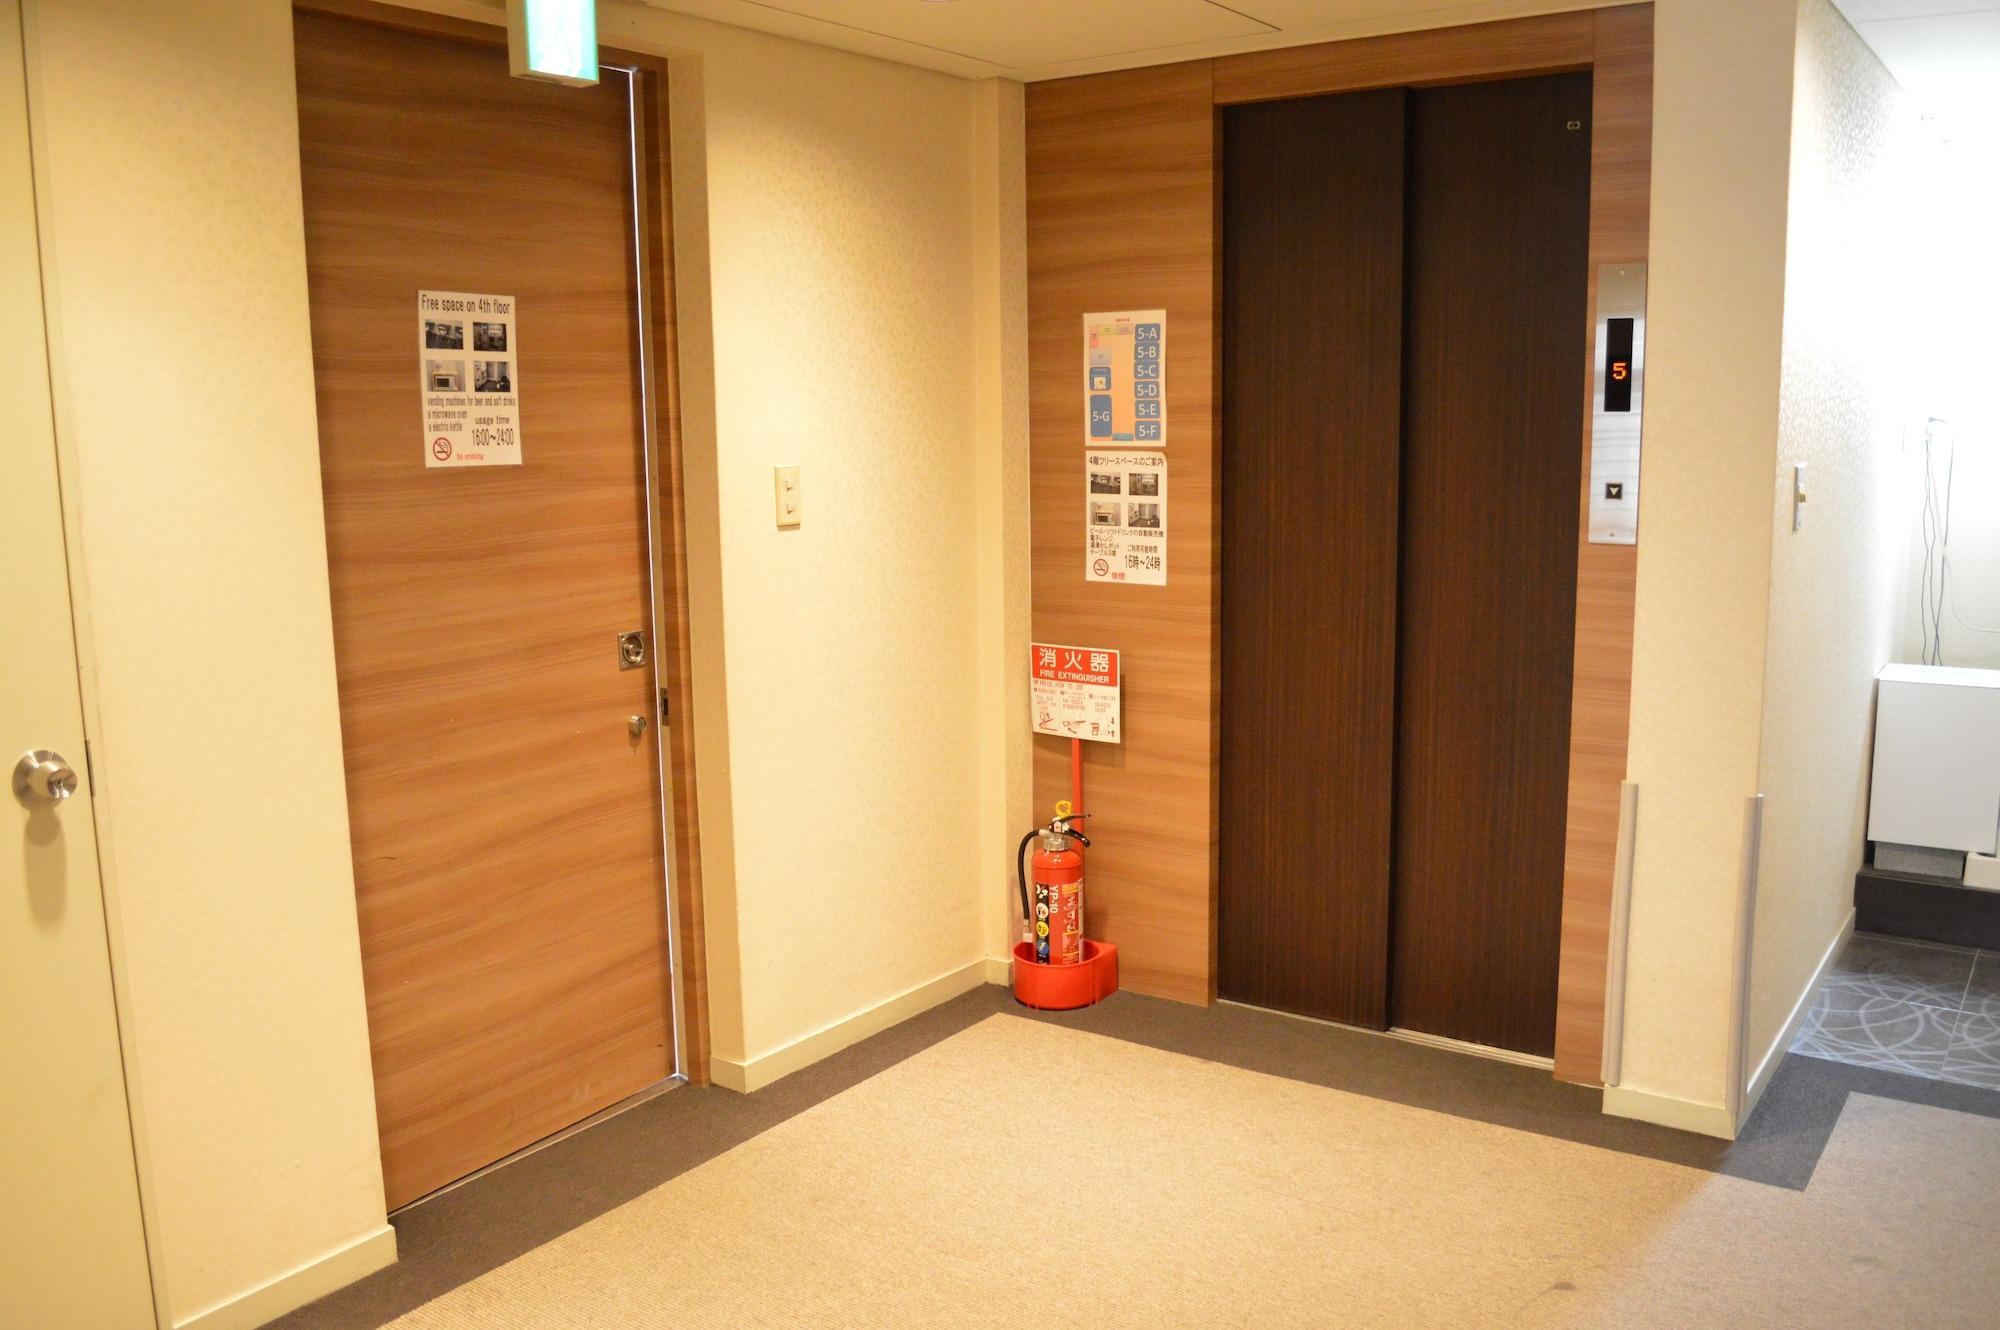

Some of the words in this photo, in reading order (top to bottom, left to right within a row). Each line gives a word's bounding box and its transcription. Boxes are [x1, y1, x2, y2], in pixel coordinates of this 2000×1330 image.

[422, 294, 440, 311] Free
[442, 298, 464, 314] space
[466, 301, 476, 313] on
[478, 299, 491, 314] 4th
[494, 299, 510, 315] floor
[1138, 328, 1157, 340] 5-A
[1137, 346, 1156, 358] 5-B
[1137, 364, 1157, 377] 5-C
[1612, 362, 1627, 380] 5
[1137, 384, 1157, 396] 5-D
[428, 396, 445, 408] vending
[446, 395, 466, 407] machines
[432, 409, 456, 419] microwave
[457, 411, 468, 419] oven
[1138, 403, 1157, 416] 5-E
[475, 417, 494, 426] usage
[496, 416, 510, 425] time
[1092, 411, 1110, 422] 5-G
[433, 422, 449, 432] electric
[450, 421, 463, 432] kettle
[1139, 424, 1157, 437] 5-F
[1039, 669, 1055, 678] FIRE
[1058, 671, 1109, 684] EXTINGUISHER
[1049, 885, 1059, 914] YP-10
